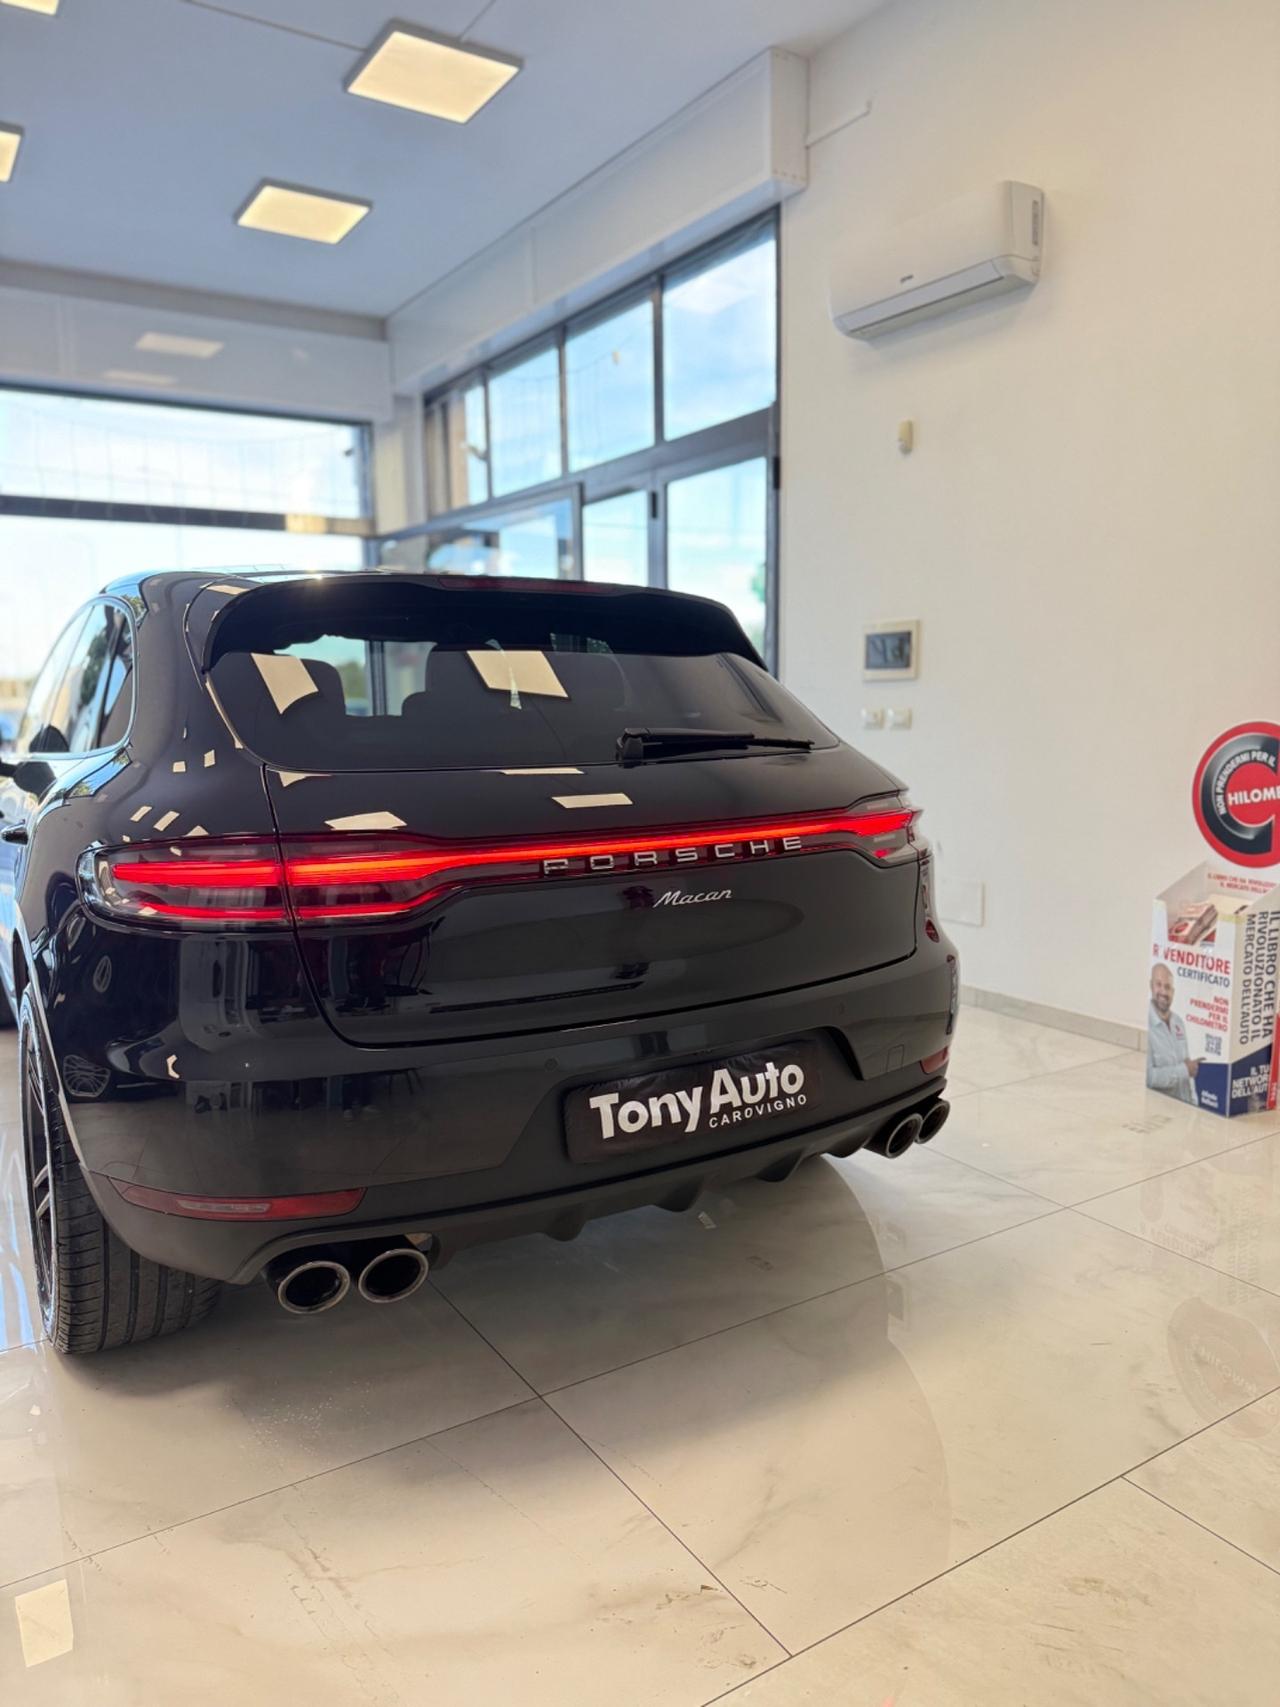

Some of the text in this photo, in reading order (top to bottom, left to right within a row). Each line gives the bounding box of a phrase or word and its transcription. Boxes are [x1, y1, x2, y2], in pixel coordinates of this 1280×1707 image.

[1251, 751, 1269, 763] PER
[543, 836, 802, 874] PORSCHE
[653, 889, 732, 908] Macan
[1153, 943, 1230, 975] RVENDITORE
[1265, 928, 1279, 975] LIBRO
[1177, 966, 1230, 988] CERTIFICATO
[1239, 913, 1256, 1045] MERCATO DELL'AUTO
[1250, 911, 1269, 1042] RIVOLUZIONATO IL
[1190, 999, 1229, 1015] PRENDERMI
[1214, 995, 1229, 1007] NON
[1263, 980, 1276, 1011] CHE
[1208, 1011, 1221, 1022] PER
[1262, 1015, 1274, 1039] HA
[589, 1062, 805, 1139] Tony Auto
[709, 1094, 807, 1128] CAROVIGNO
